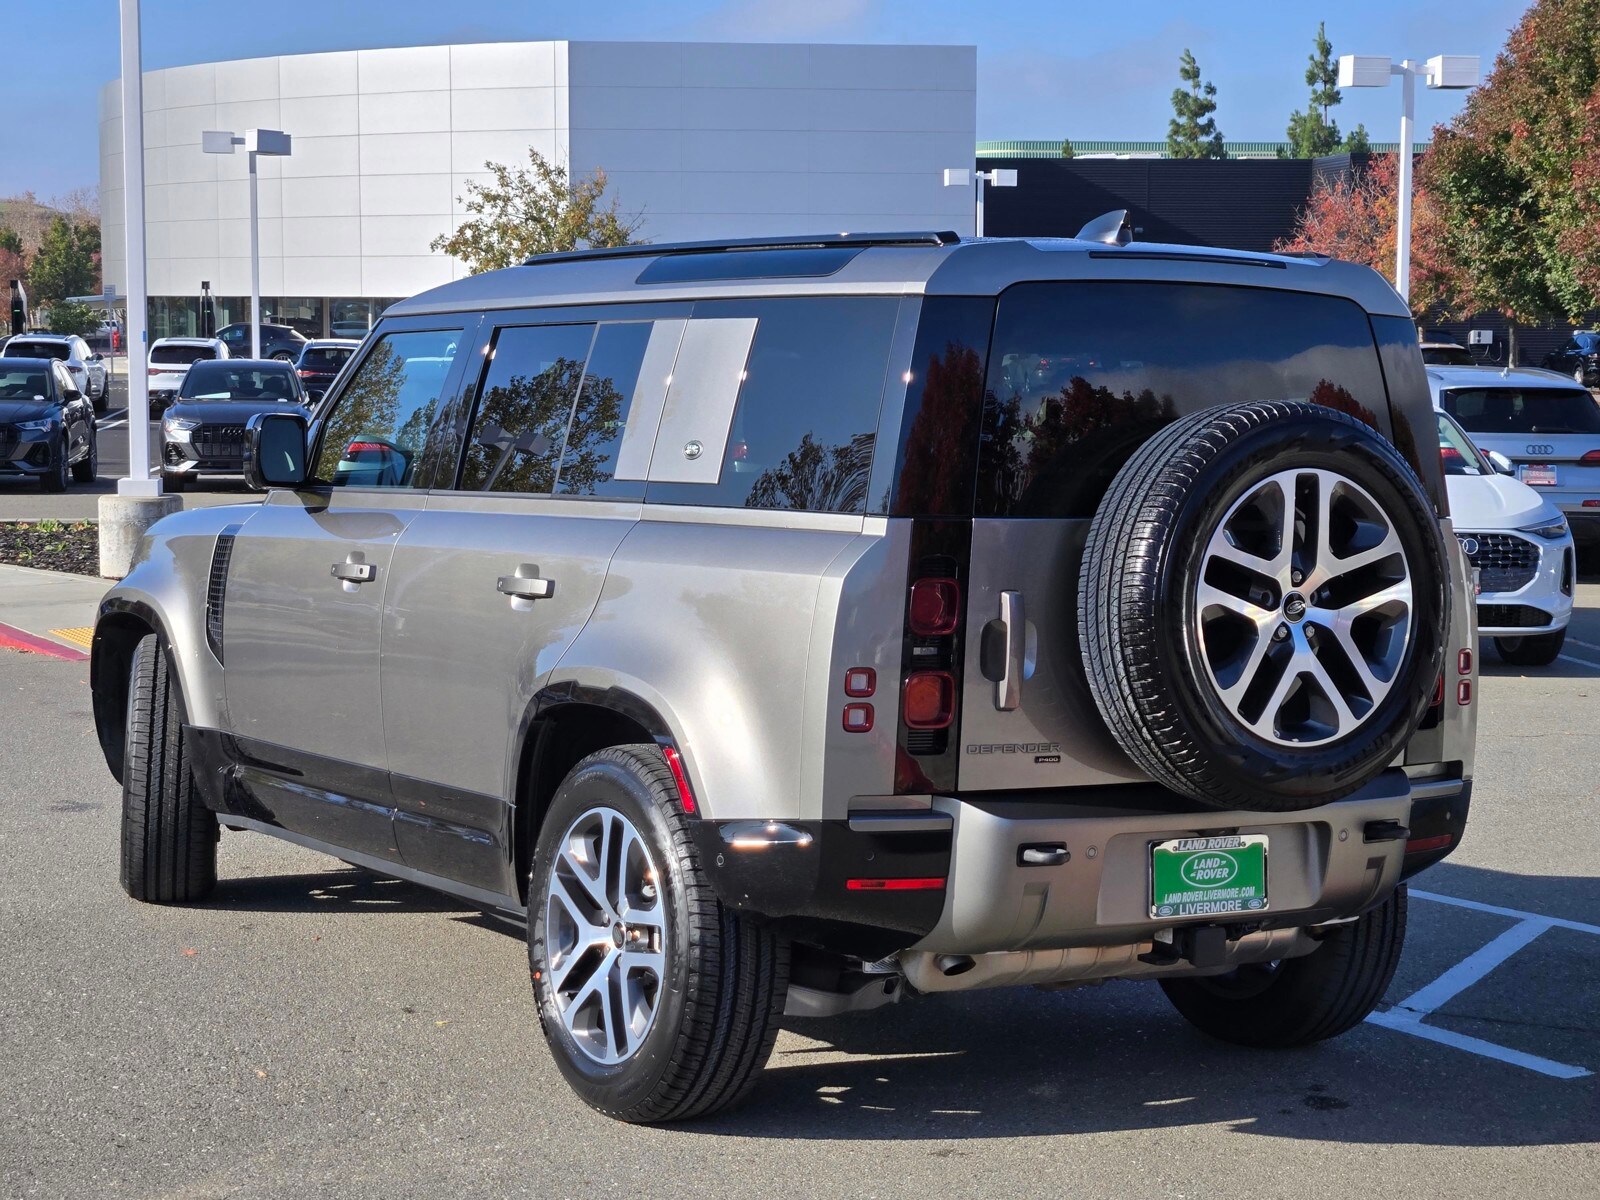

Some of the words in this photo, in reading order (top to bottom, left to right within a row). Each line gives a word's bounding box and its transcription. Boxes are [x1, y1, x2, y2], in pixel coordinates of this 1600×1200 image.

[967, 743, 1060, 754] DEFENDER
[1180, 840, 1206, 850] LAND
[1207, 837, 1240, 848] ROVER
[1194, 858, 1220, 869] LAND
[1196, 868, 1229, 880] ROVER
[1180, 900, 1241, 914] LIVERMORE
